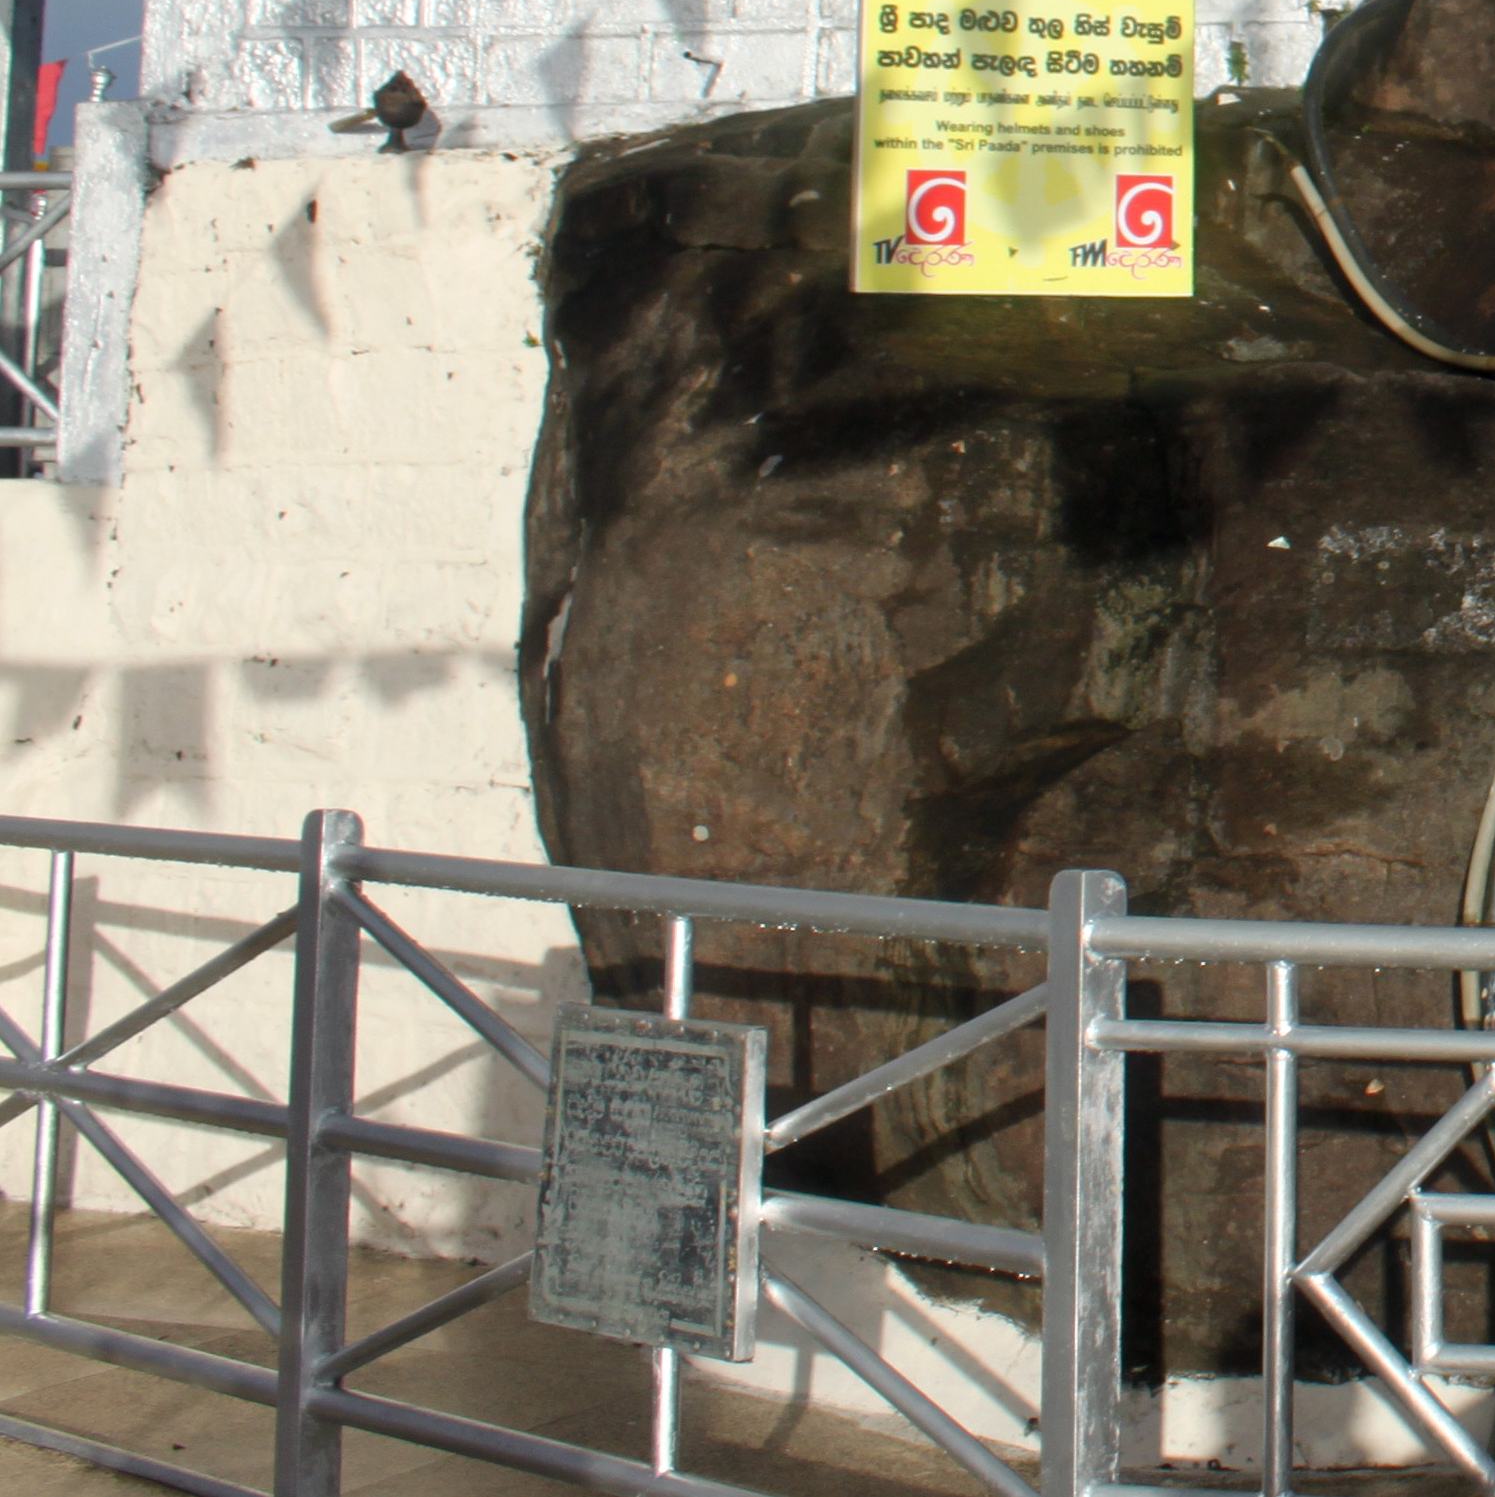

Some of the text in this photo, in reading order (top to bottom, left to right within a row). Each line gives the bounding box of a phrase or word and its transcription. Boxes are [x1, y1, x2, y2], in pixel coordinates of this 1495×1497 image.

[908, 11, 950, 35] පාද
[936, 120, 1125, 137] Wearing helmets and shoes
[874, 137, 917, 148] within
[921, 138, 943, 150] the
[1031, 142, 1094, 154] premises
[1097, 142, 1109, 154] is
[1113, 143, 1182, 156] prohibited
